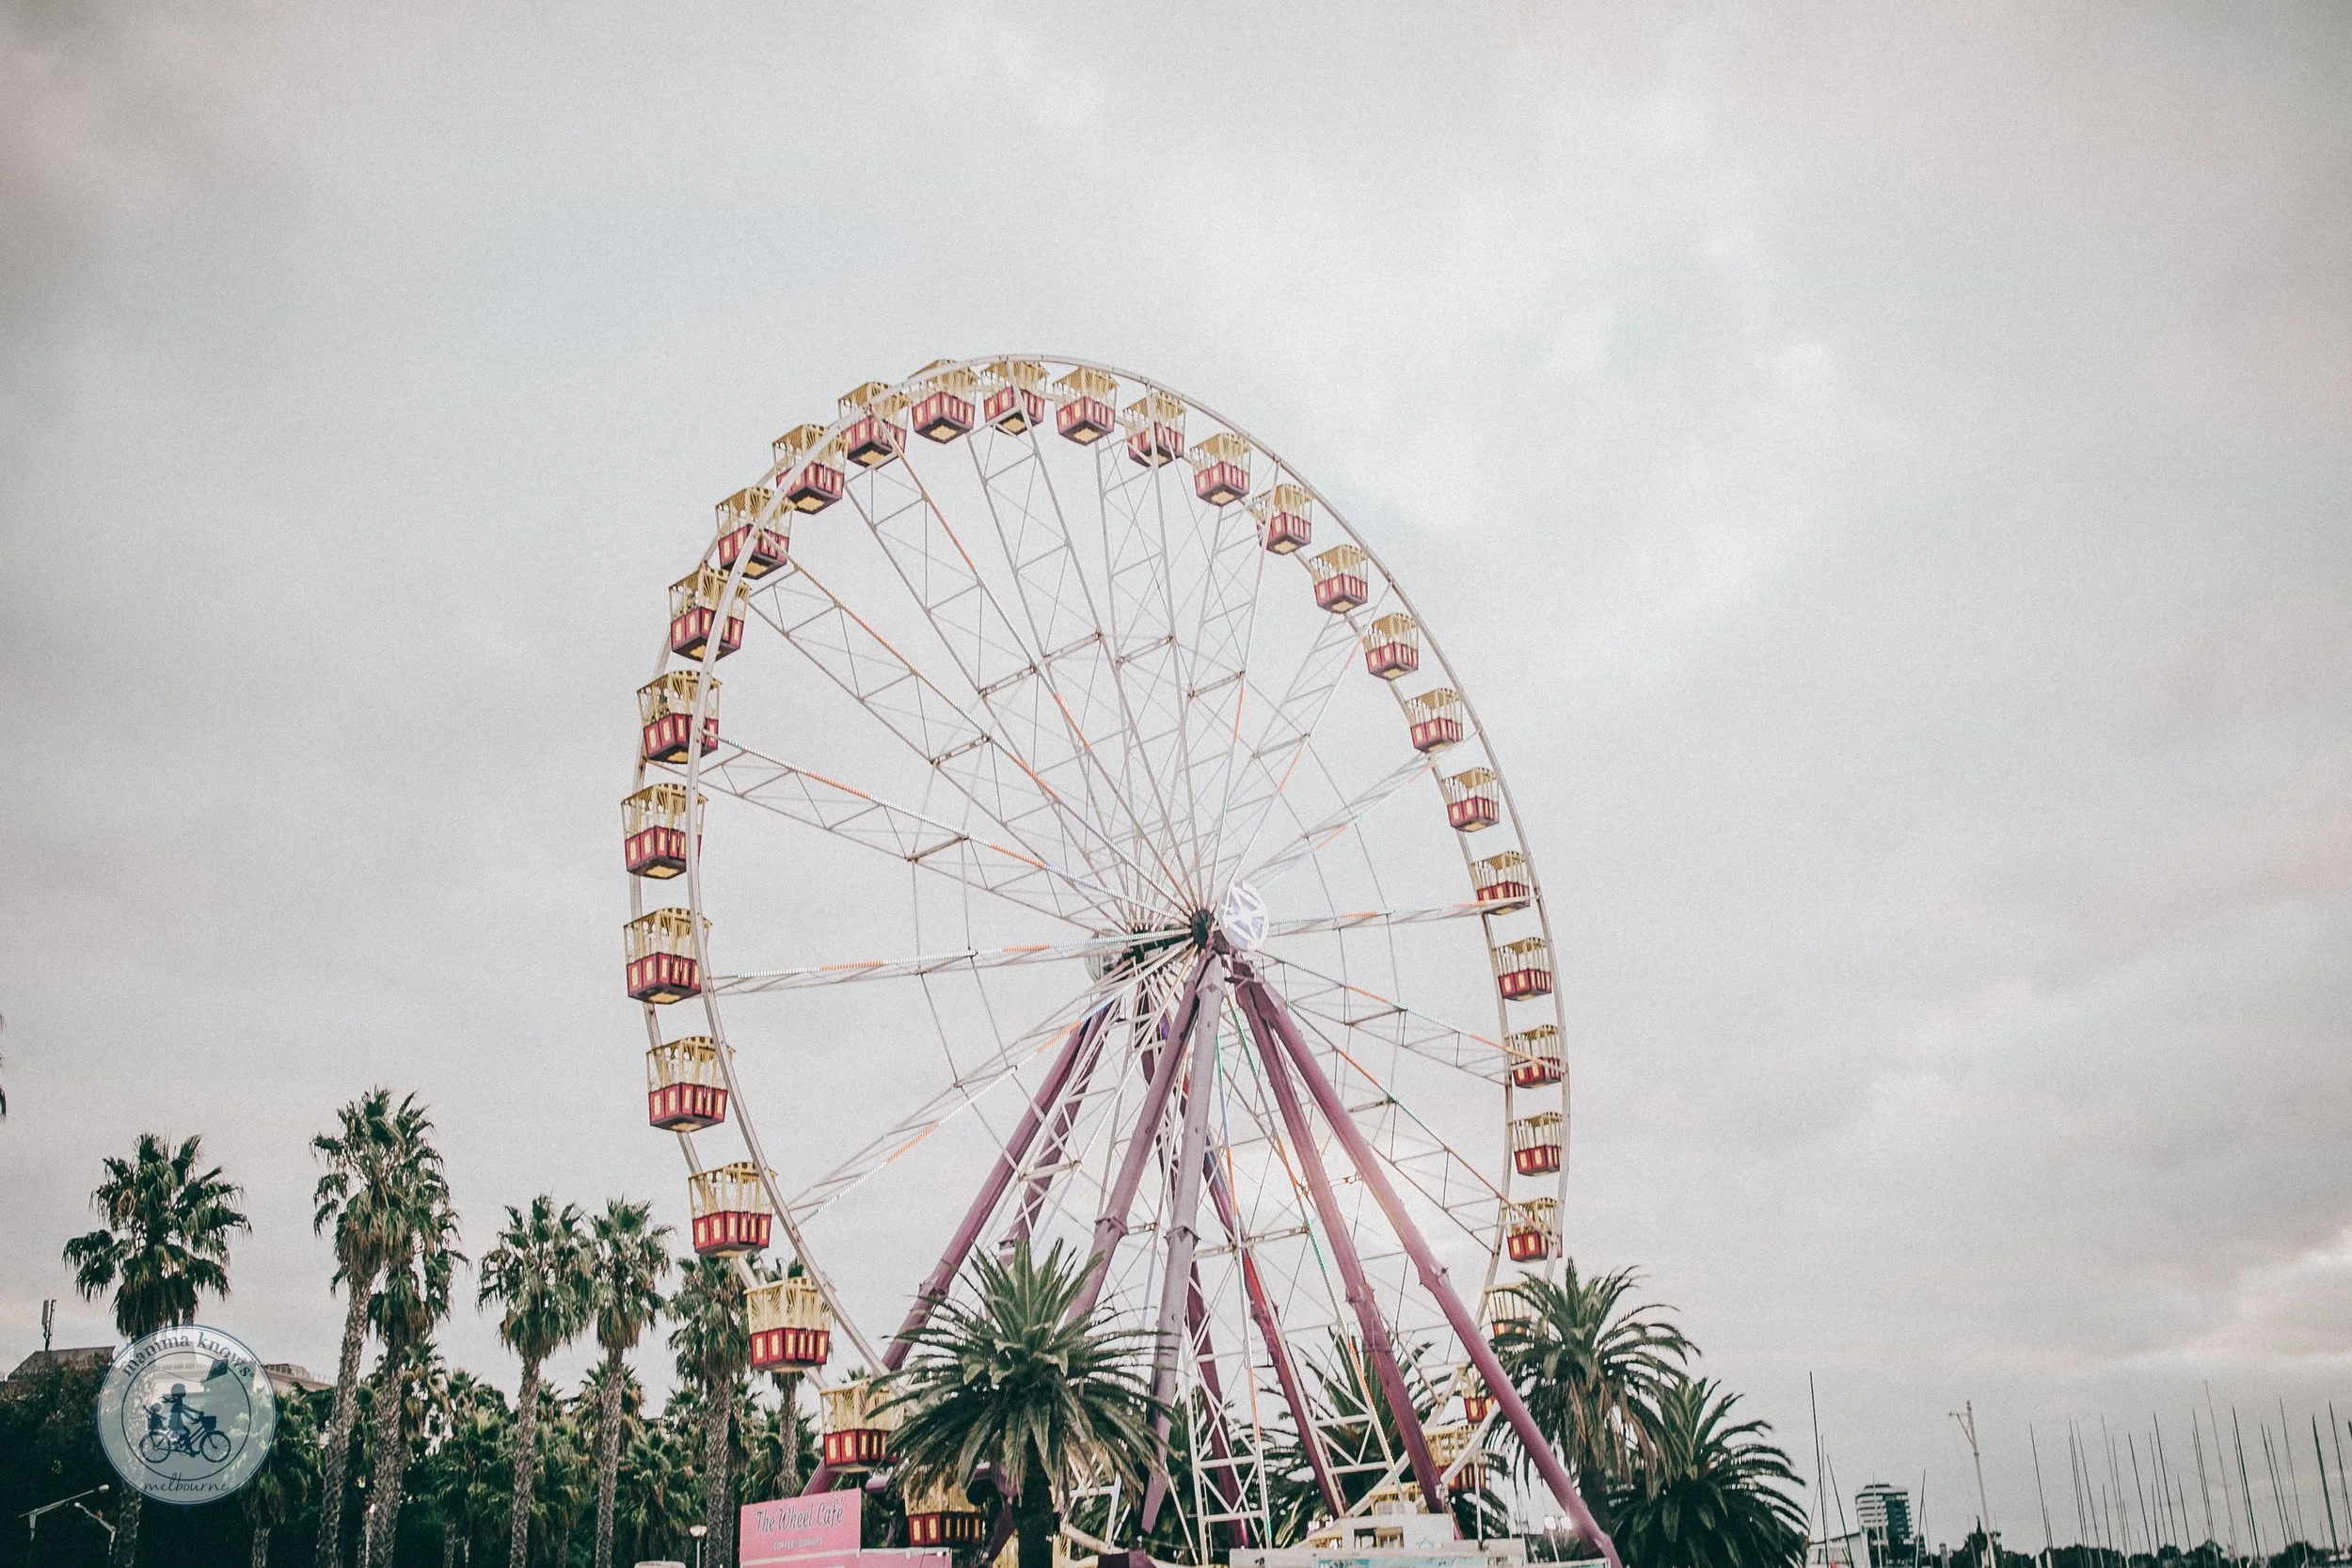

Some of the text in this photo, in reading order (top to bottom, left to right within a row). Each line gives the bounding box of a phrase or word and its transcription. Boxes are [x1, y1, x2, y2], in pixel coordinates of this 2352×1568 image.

[756, 1497, 844, 1532] The Wheel Café
